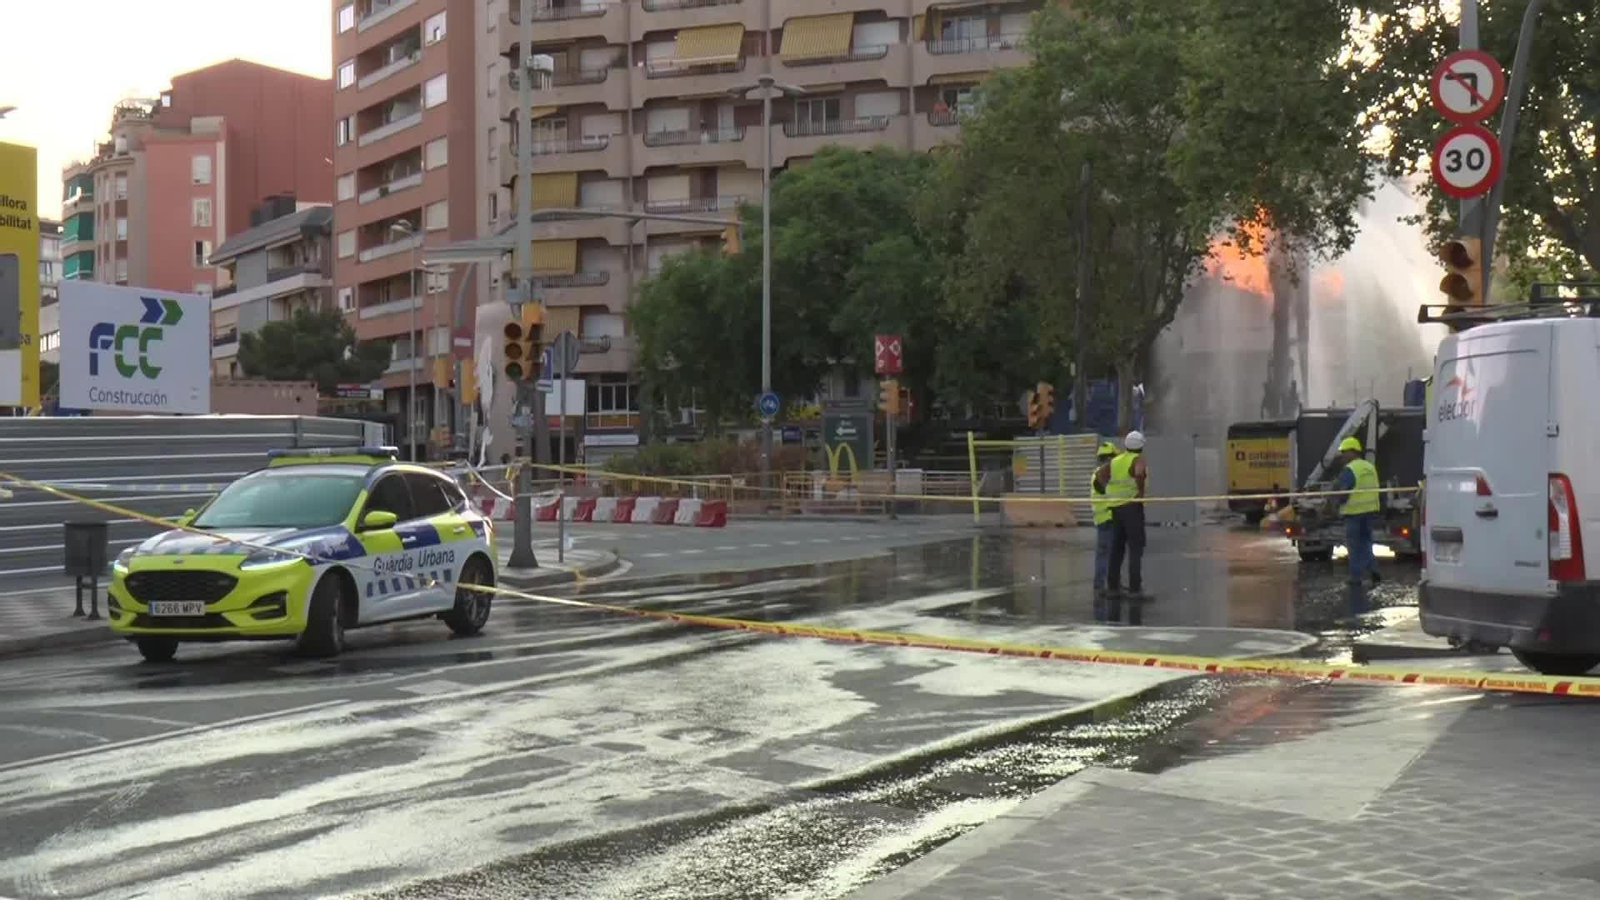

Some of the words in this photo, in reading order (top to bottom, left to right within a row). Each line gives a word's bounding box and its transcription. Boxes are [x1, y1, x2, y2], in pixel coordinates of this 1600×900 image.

[1446, 148, 1484, 172] 30
[89, 386, 167, 405] Construcción
[418, 548, 455, 568] Urbana
